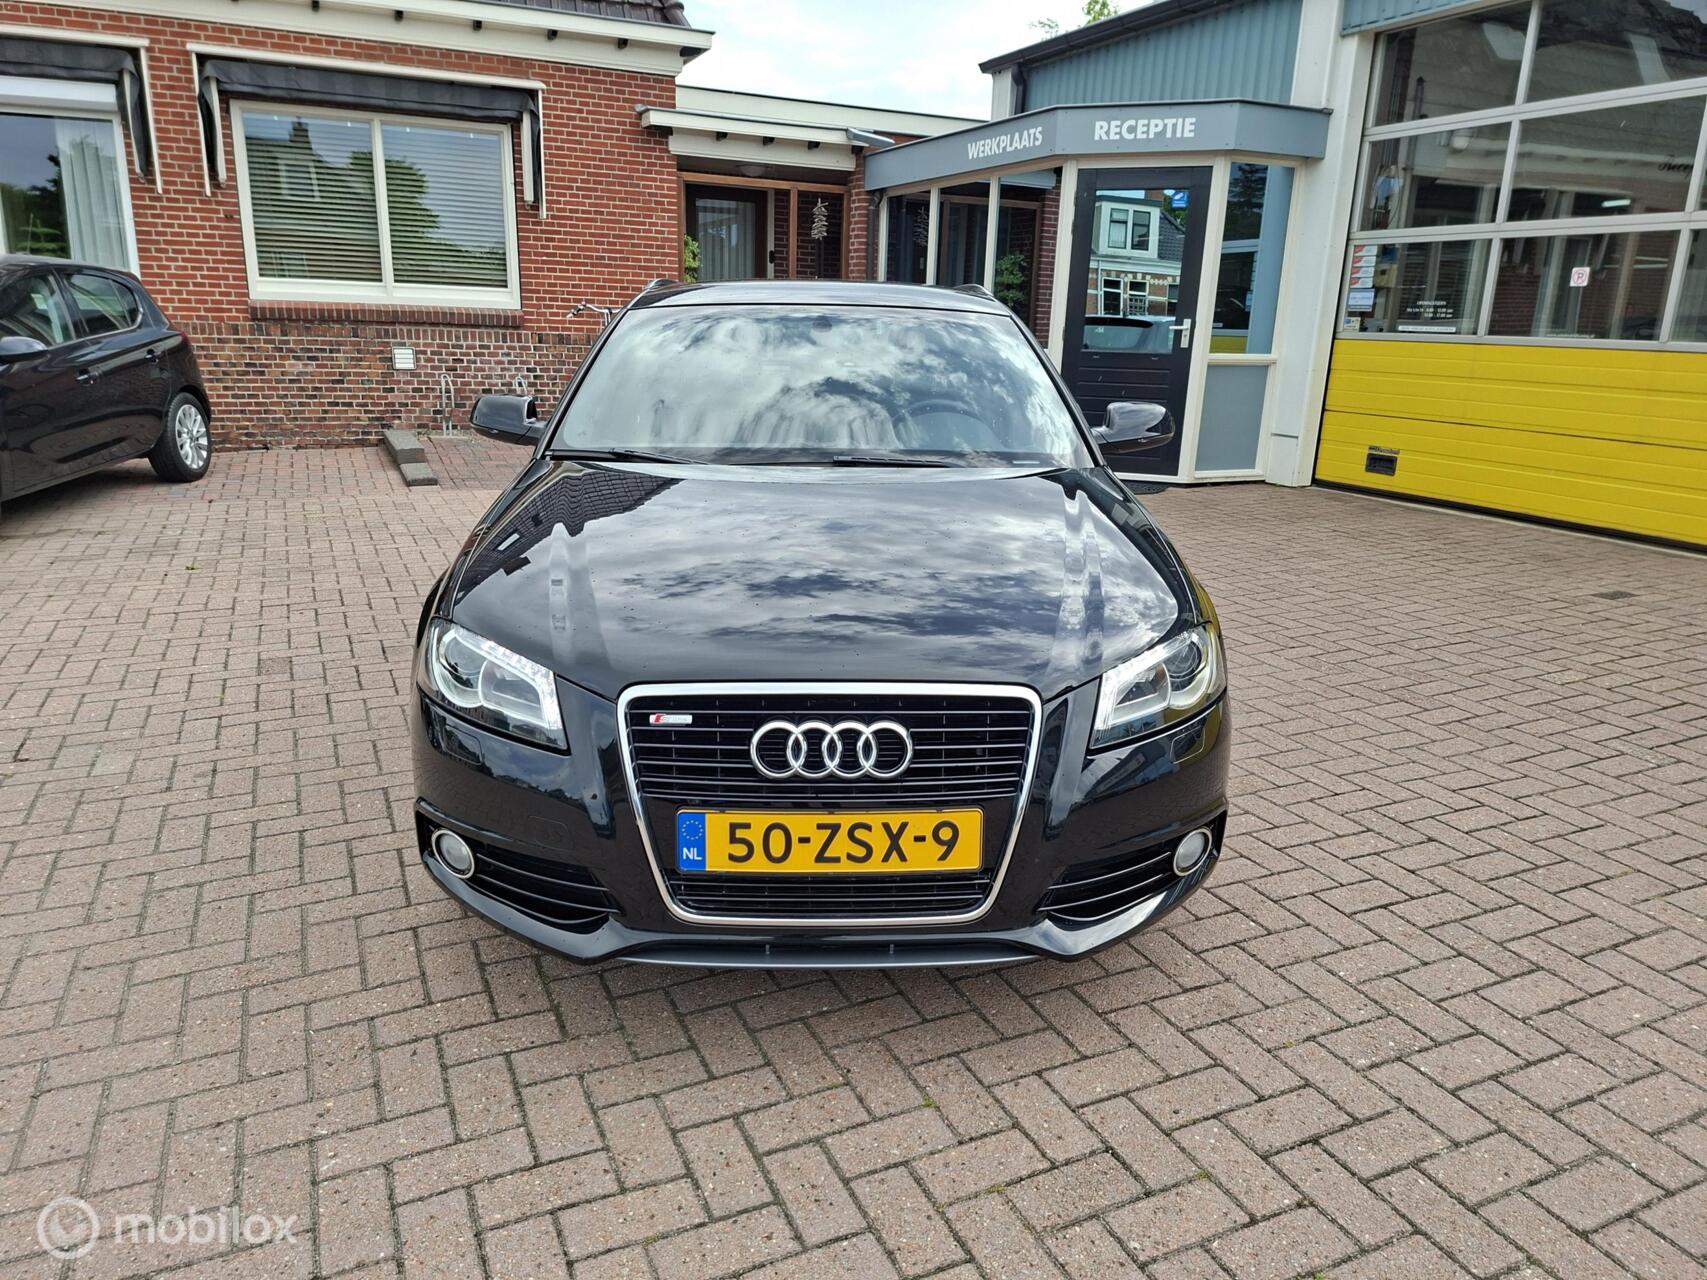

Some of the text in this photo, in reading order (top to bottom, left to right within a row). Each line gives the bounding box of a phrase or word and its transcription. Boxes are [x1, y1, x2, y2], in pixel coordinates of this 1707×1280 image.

[967, 126, 1043, 160] WERKPLAATS
[1094, 117, 1197, 141] RECEPTIE
[682, 847, 702, 860] NL
[727, 820, 960, 864] 50-ZSX-9
